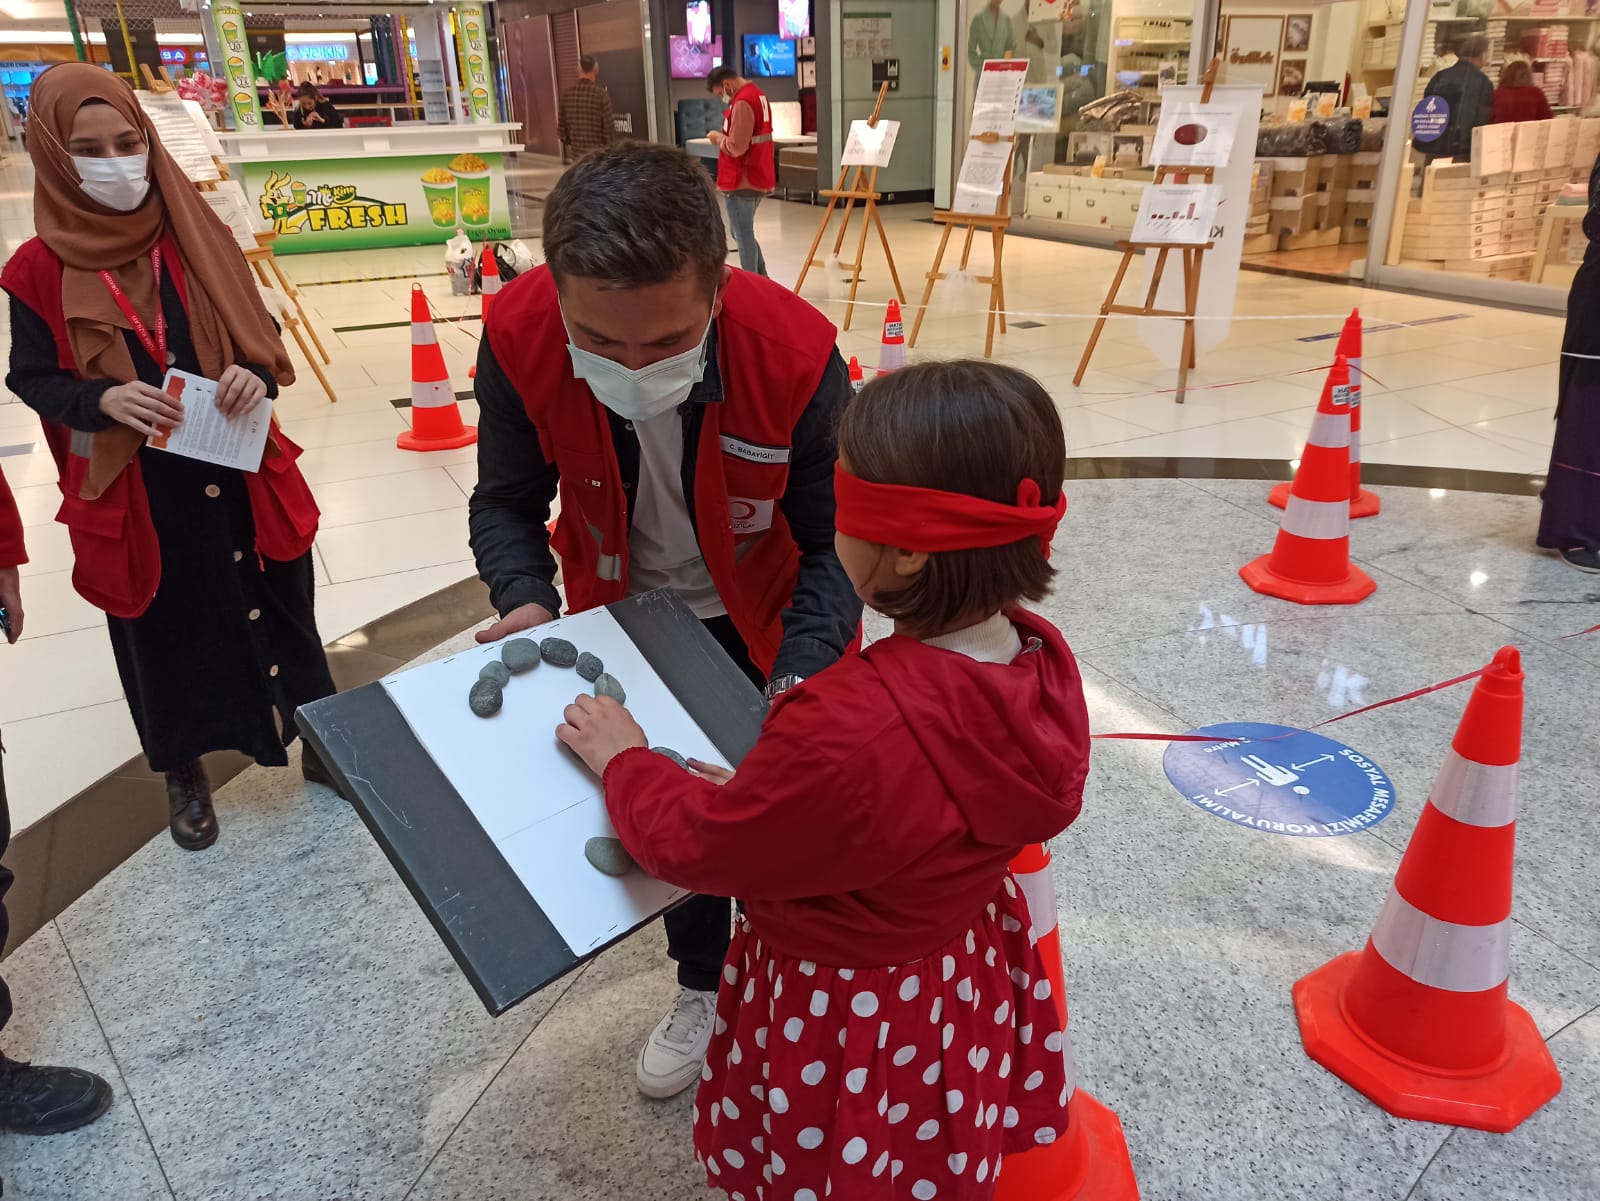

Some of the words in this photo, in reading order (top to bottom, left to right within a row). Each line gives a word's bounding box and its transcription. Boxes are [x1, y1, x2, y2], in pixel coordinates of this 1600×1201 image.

[307, 203, 408, 231] FRESH
[1338, 749, 1387, 786] SOSYAL
[1321, 787, 1391, 836] MESAFEMİZİ
